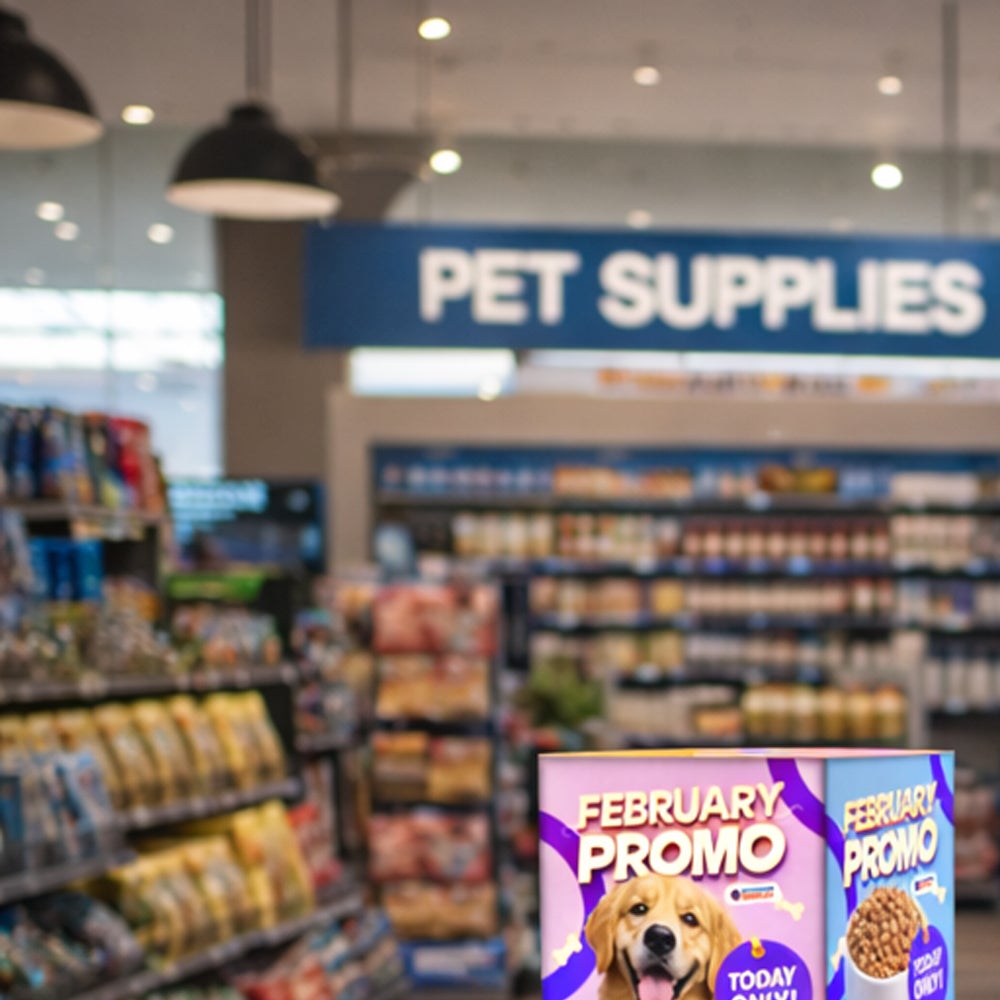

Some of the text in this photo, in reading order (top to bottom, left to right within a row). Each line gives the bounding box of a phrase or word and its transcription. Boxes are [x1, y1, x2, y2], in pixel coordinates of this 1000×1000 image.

[419, 248, 985, 335] PET SUPPLIES
[577, 781, 785, 831] FEBRUARY
[843, 781, 938, 838] FEBRUARY
[577, 822, 787, 884] PROMO
[843, 818, 939, 888] PROMO
[728, 965, 798, 991] TODAY
